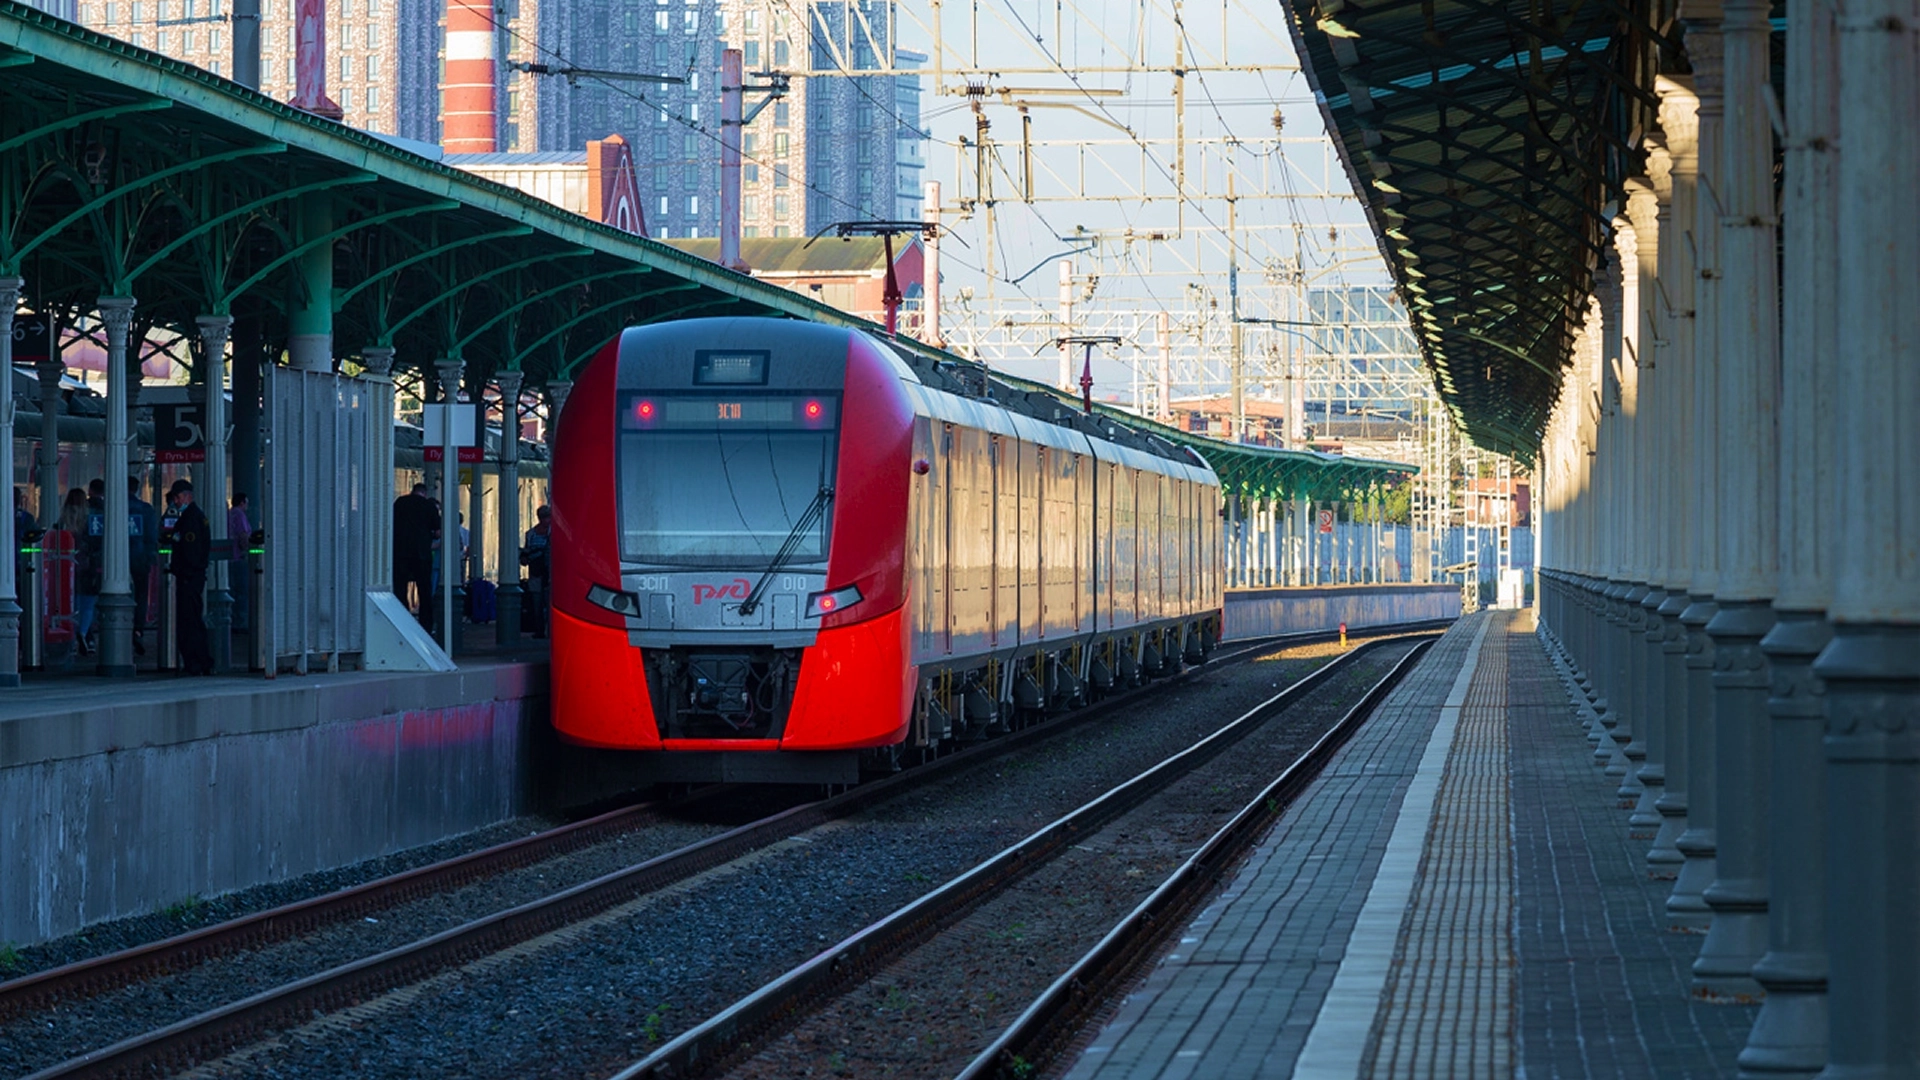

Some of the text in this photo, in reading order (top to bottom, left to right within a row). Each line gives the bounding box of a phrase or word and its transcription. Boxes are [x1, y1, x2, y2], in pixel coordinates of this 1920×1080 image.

[13, 321, 25, 341] 6
[174, 405, 199, 449] 5
[429, 449, 443, 461] Пу
[783, 576, 806, 591] 010
